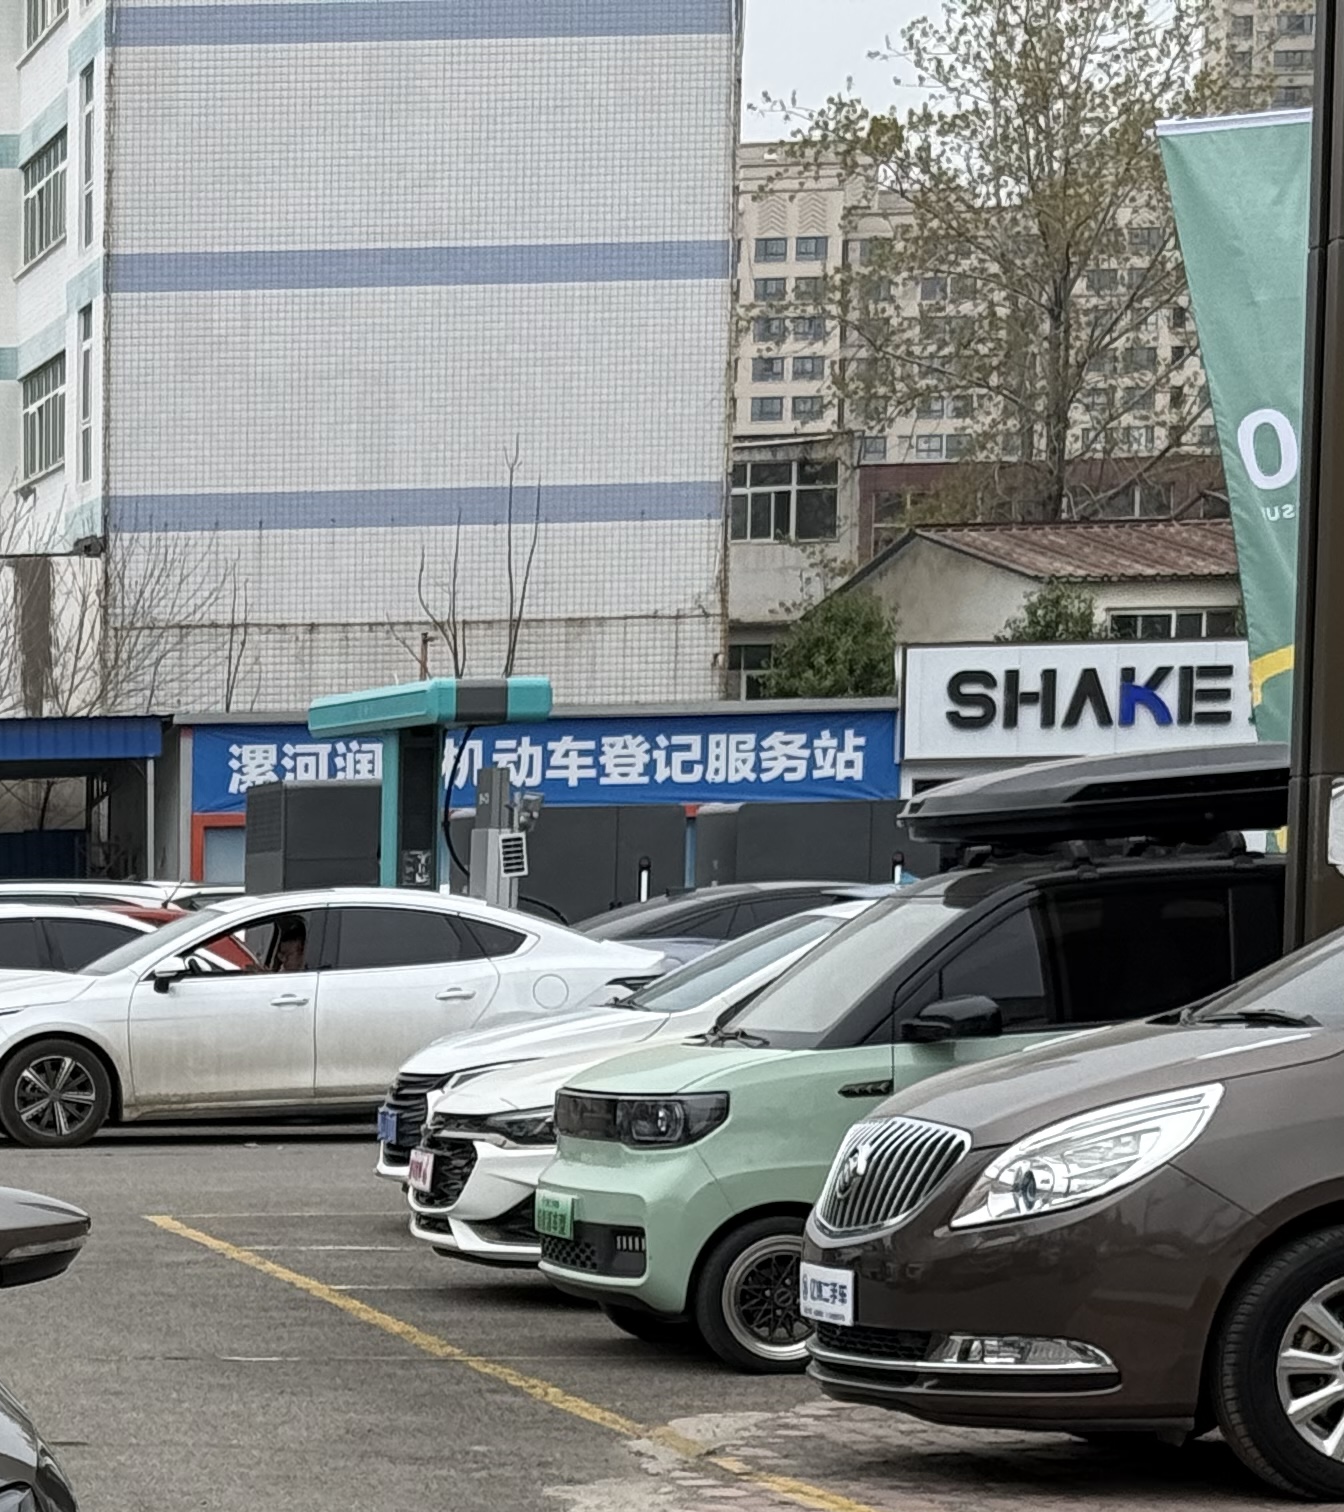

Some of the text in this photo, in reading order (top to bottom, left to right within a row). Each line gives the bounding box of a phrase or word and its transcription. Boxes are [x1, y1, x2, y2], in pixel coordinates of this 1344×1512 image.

[945, 664, 1234, 730] SHAKE
[228, 728, 866, 794] 漯河润机动车登记服务站
